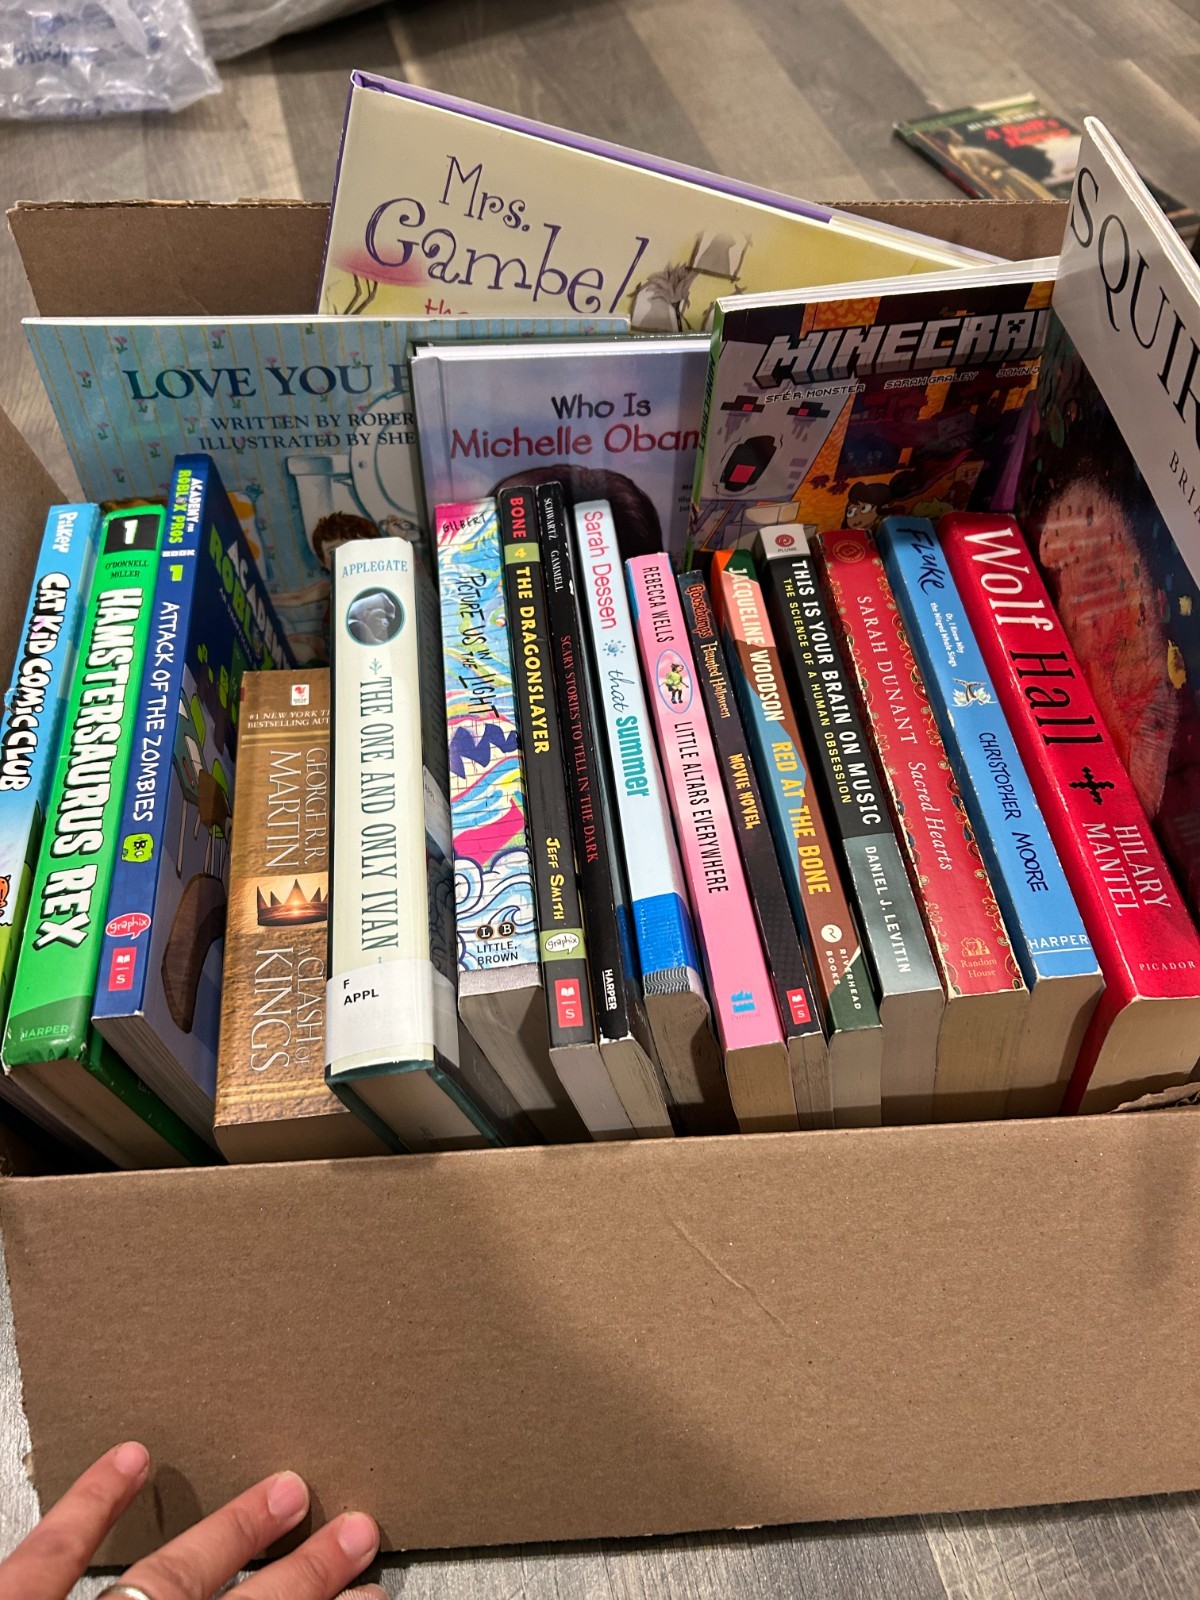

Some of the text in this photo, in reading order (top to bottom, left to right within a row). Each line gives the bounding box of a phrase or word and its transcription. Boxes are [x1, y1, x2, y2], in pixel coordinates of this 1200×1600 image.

[438, 155, 530, 232] Mrs.
[365, 197, 650, 313] Gambel
[122, 368, 256, 400] LOVE
[265, 365, 374, 396] YOU
[552, 392, 652, 420] Who Is
[806, 384, 866, 398] MONSTER
[884, 371, 979, 389] SARAH GRALEY
[199, 434, 340, 450] ILLUSTRATED
[346, 434, 372, 446] BY
[211, 415, 310, 430] WRITTEN
[317, 414, 342, 428] BY
[450, 426, 592, 459] Michelle
[169, 515, 187, 544] PROS
[187, 477, 203, 523] ACADEMY
[442, 512, 488, 533] GILBERT
[510, 496, 527, 538] BONE
[123, 519, 139, 545] 1
[162, 550, 195, 558] BOOK
[514, 547, 527, 558] 4
[543, 498, 564, 592] SCHWARTZ GAMMELL
[37, 572, 71, 613] CAT
[105, 560, 149, 569] O'DONNELL
[111, 570, 140, 578] MILLER
[169, 564, 183, 582] 1
[342, 560, 408, 578] APPLEGATE
[584, 510, 617, 630] Sarah Dessen
[457, 572, 493, 661] PICTURE US IN
[642, 566, 674, 643] REBECCA WELLS
[688, 583, 715, 638] Goosebumps
[516, 566, 550, 754] THE DRAGONSLAYER
[729, 567, 785, 722] JACQUELINE WOODSON
[930, 602, 957, 667] the Winged Whale Sings
[950, 626, 959, 641] Know
[956, 641, 964, 654] Why
[964, 527, 1104, 747] Wolf Hall
[459, 651, 500, 719] THE LIGHT
[700, 640, 731, 719] Haunted Halloween
[783, 578, 852, 804] THE SCIENCE OF A HUMAN OBSESSION
[791, 559, 881, 825] THIS IS YOUR BRAIN ON MUSIC
[857, 595, 918, 745] SARAH DUNANT
[133, 601, 180, 822] ATTACK OF THE ZOMBIES
[248, 719, 309, 729] BESTSELLING
[608, 668, 650, 798] that summer
[32, 586, 143, 950] HAMSTERSAURUS REX
[560, 634, 600, 864] SCARY STORIES TO TELL IN THE DARK
[266, 750, 302, 867] MARTIN
[304, 747, 328, 865] GEORGE R. R.
[360, 676, 399, 951] THE ONE AND ONLY IVAN
[674, 721, 729, 895] LITTLE ALTARS EVERYWHERE
[727, 753, 761, 830] MOVIE NOVEL
[771, 741, 829, 895] RED AT THE BONE
[907, 761, 953, 871] Sacred Hearts
[978, 732, 1049, 893] CHRISTOPHER MOORE
[546, 837, 565, 920] JEFF SMITH
[1081, 822, 1140, 917] MANTEL
[1112, 824, 1172, 909] HILARY
[109, 916, 147, 934] graphix
[864, 845, 912, 974] DANIEL J. LEVITIN
[476, 940, 518, 953] LITTLE,
[477, 952, 518, 965] BROWN
[547, 935, 578, 951] graphix
[825, 950, 841, 986] BOOKS
[960, 956, 998, 968] Random
[1029, 934, 1089, 950] HARPER
[1138, 960, 1196, 972] PICADOR
[343, 978, 350, 989] F
[343, 988, 379, 1005] APPL
[603, 969, 617, 1010] HARPER
[838, 948, 862, 1011] RIVERHEAD
[968, 968, 997, 979] House
[250, 947, 294, 1072] KINGS
[295, 944, 325, 1065] A CLASH OF
